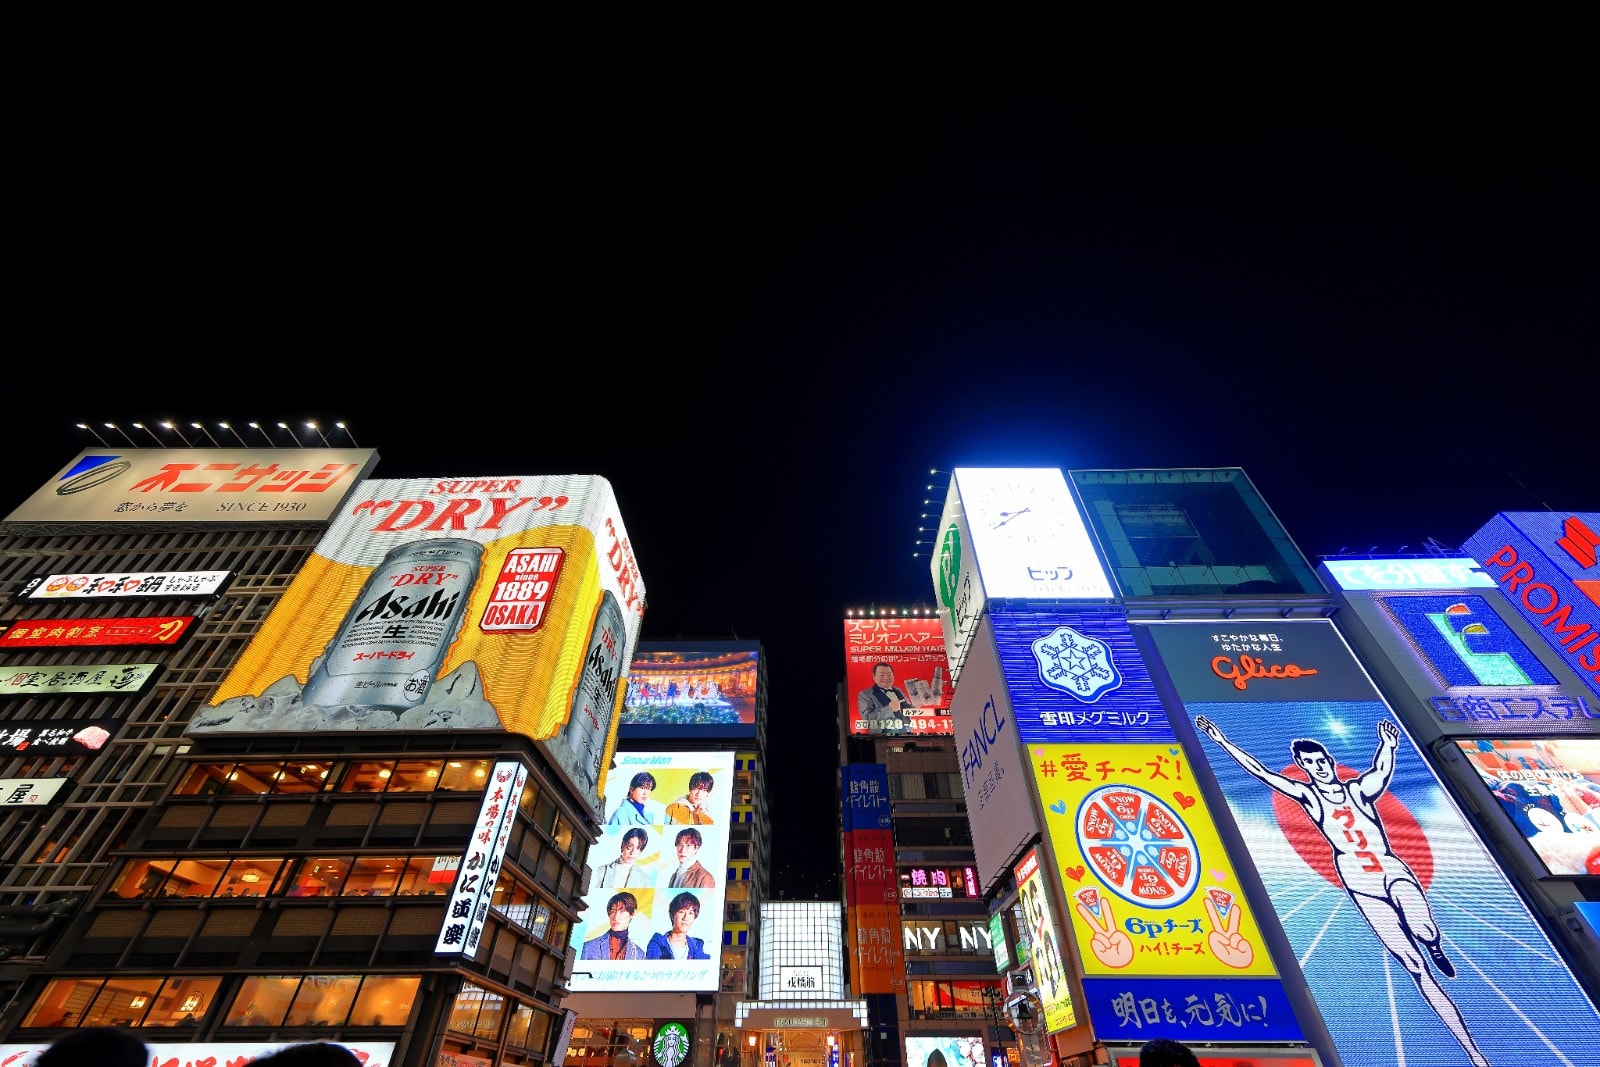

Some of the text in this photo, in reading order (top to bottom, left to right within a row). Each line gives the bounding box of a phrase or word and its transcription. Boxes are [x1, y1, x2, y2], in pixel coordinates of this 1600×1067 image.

[128, 463, 358, 492] 不二サッシ
[429, 479, 521, 494] SUPER
[114, 501, 188, 513] 窓から夢を
[216, 501, 307, 513] SINCE 1930
[504, 554, 559, 573] ASAHI
[515, 573, 539, 582] since
[496, 581, 549, 601] 1889
[355, 588, 460, 623] Asahi
[484, 603, 541, 626] OSAKA
[849, 620, 900, 632] スーパー
[1485, 544, 1600, 692] PROMIS
[382, 625, 409, 638] 生
[849, 633, 944, 644] ミリオンヘアー
[353, 651, 415, 661] スーパードライ
[850, 645, 882, 653] SUPER
[885, 645, 920, 653] MILLION
[1221, 643, 1282, 651] ゆたかな人生
[588, 643, 616, 702] Asahi
[1211, 655, 1318, 691] Glico
[1040, 711, 1149, 725] 雪印メグミルク
[962, 694, 1005, 789] FANCL
[0, 784, 34, 804] 屋
[477, 787, 503, 845] 本場の味
[1088, 808, 1099, 833] SNOW
[1154, 808, 1179, 834] SNOW
[1332, 806, 1384, 872] グリコ
[1094, 853, 1118, 879] SNOW
[1177, 854, 1188, 881] SNOW
[911, 869, 946, 886] 焼肉
[443, 851, 485, 945] かに道楽
[1138, 887, 1167, 895] SNOW
[904, 927, 941, 949] NY
[960, 926, 992, 949] NY
